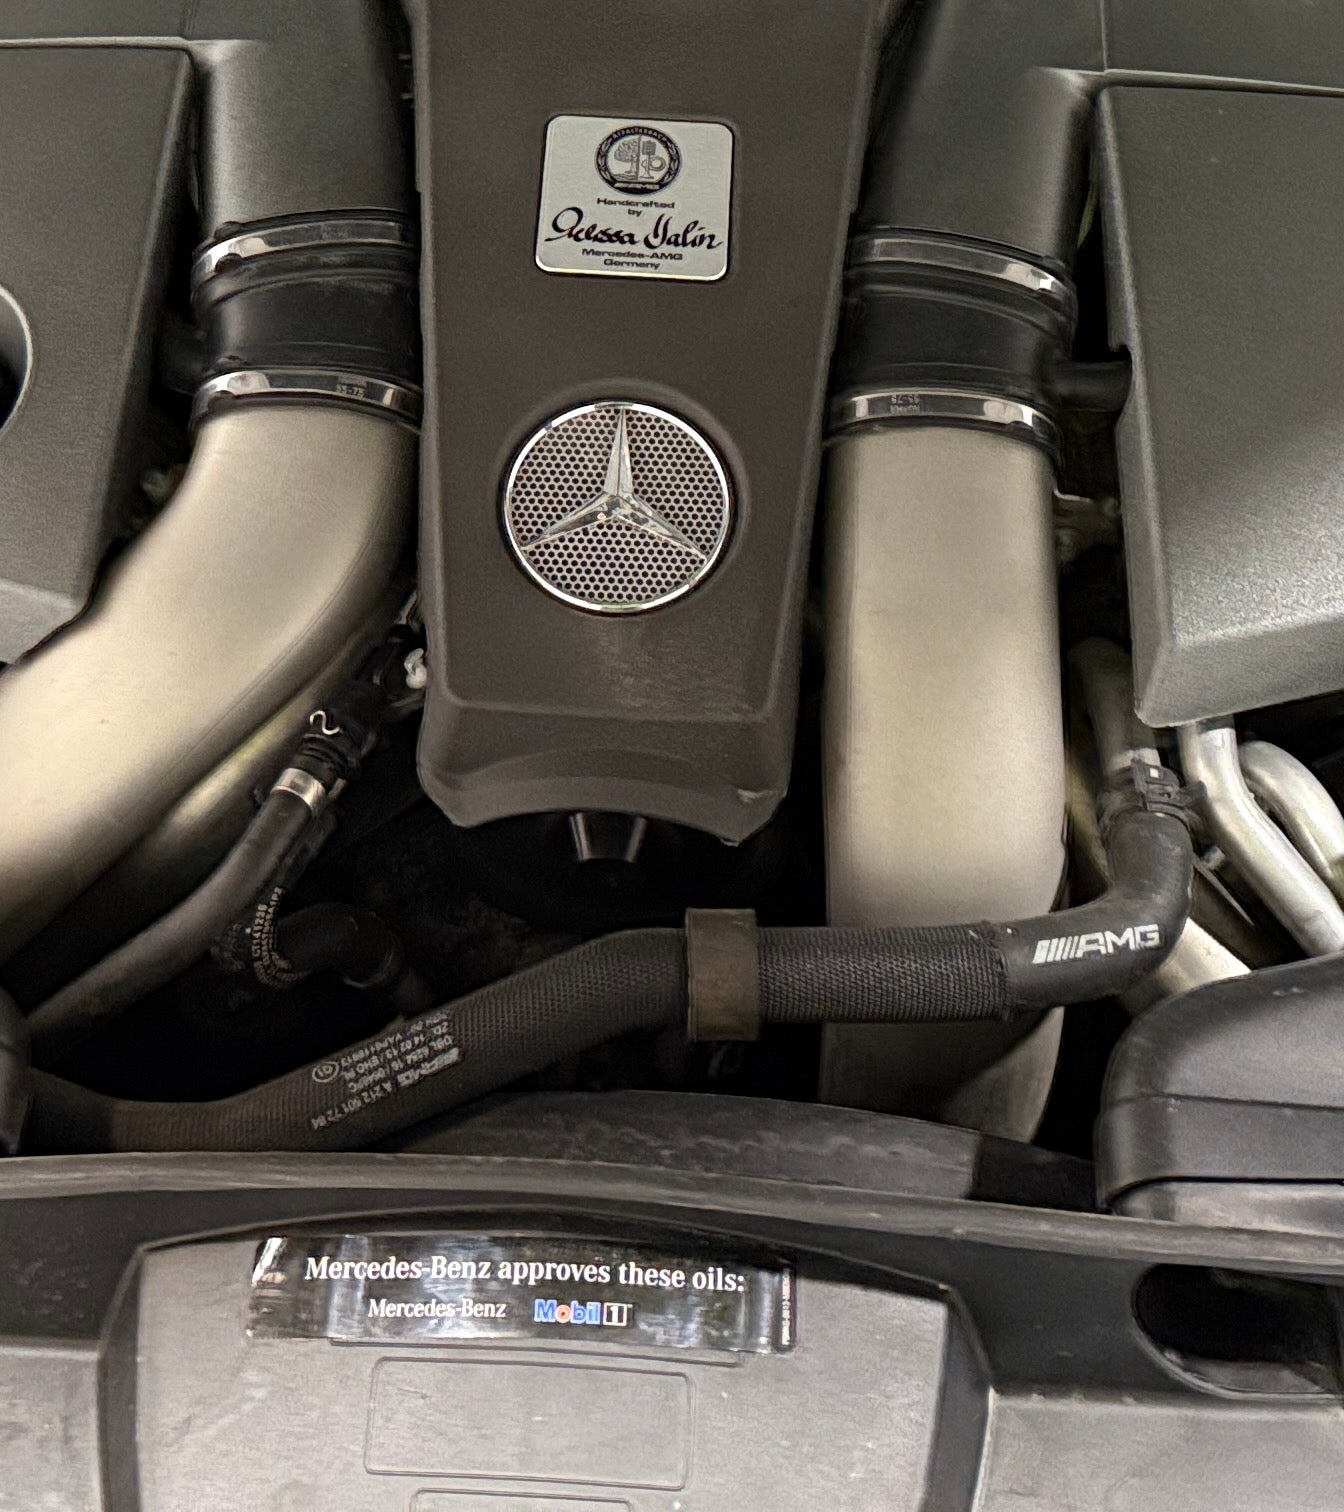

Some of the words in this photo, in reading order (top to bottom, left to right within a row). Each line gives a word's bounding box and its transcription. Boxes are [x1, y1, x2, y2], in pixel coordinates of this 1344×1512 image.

[596, 197, 675, 209] Handcrafted
[627, 208, 643, 218] by
[581, 248, 684, 261] Mercedes-AMG
[603, 258, 661, 270] Germany
[1074, 923, 1160, 959] AMG
[304, 1255, 490, 1281] Mercedes-Benz
[497, 1258, 611, 1286] approves
[618, 1261, 686, 1289] these
[692, 1266, 746, 1292] oils:
[367, 1296, 507, 1319] Mercedes-Benz
[534, 1298, 602, 1324] Mobil
